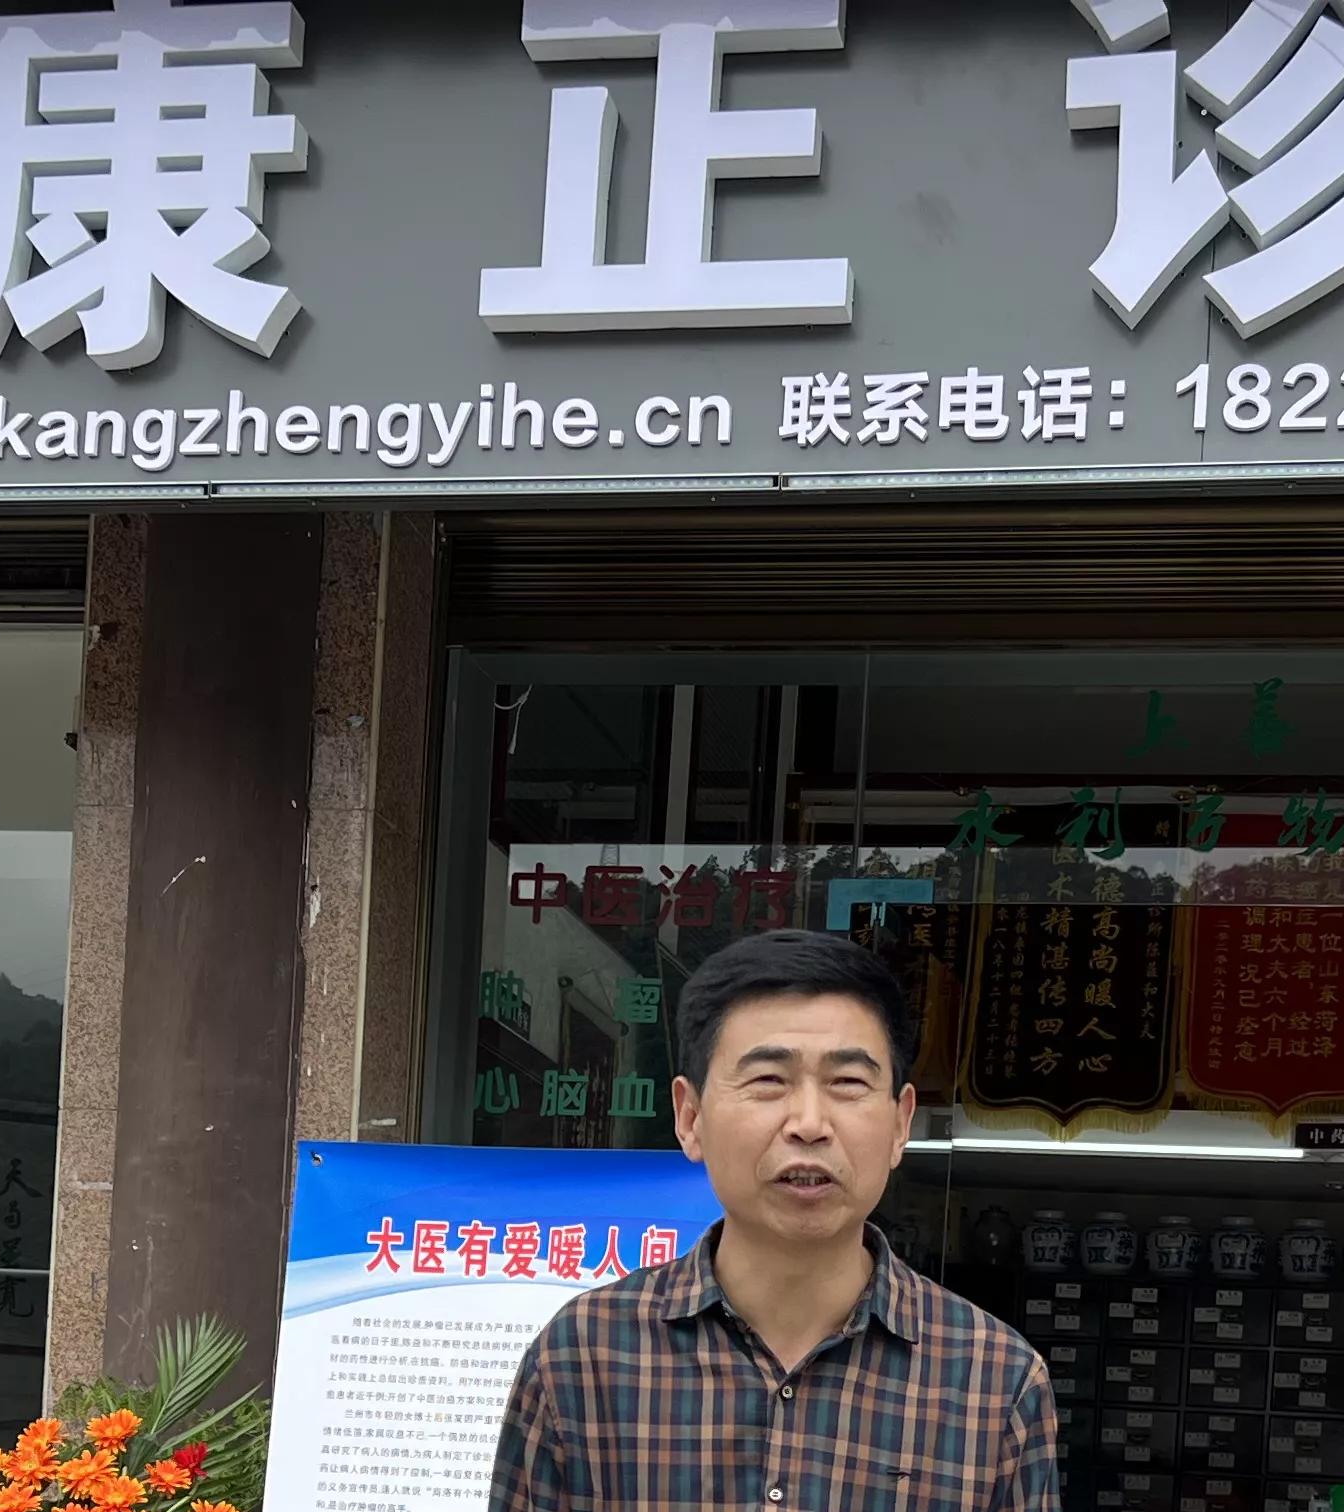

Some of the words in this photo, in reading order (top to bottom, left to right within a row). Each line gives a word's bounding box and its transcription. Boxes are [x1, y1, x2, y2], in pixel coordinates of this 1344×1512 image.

[511, 862, 798, 930] 中医治疗
[364, 1215, 679, 1281] 大医有爱暖人间
